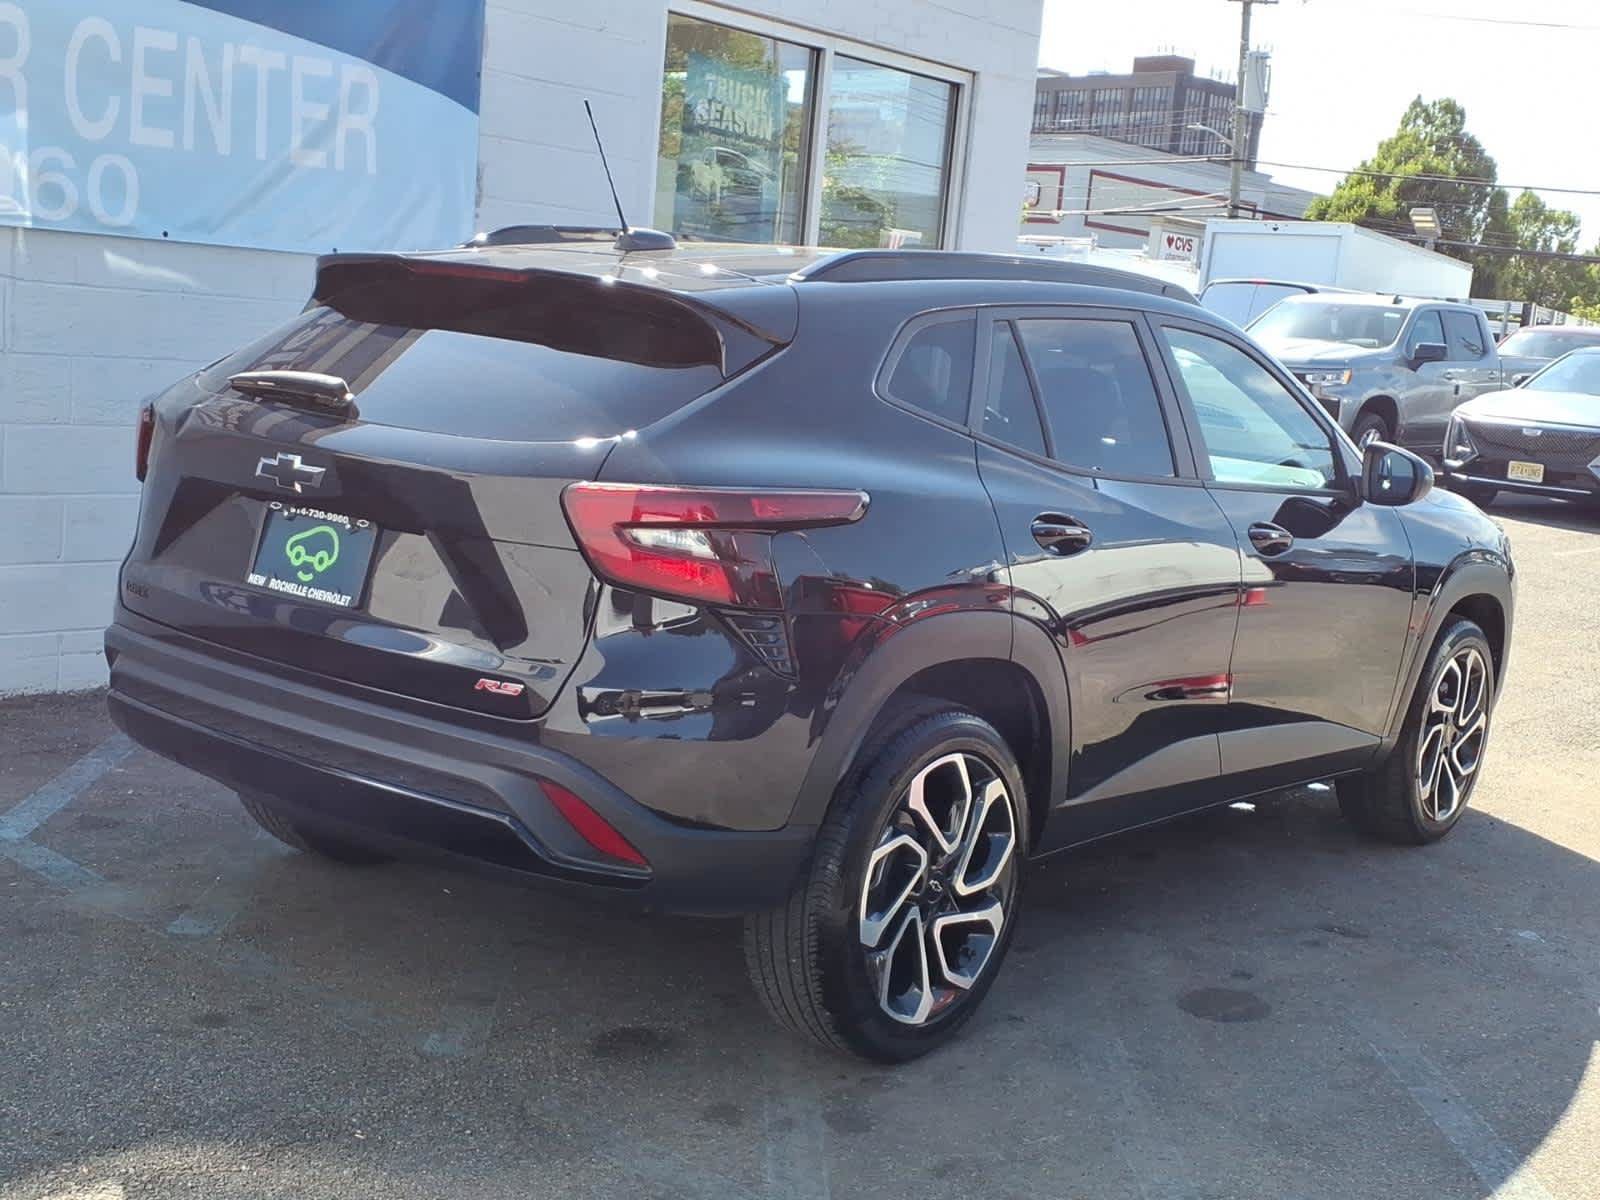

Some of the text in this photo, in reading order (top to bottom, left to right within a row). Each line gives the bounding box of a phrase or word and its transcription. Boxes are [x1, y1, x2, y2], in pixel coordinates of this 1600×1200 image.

[64, 16, 380, 175] CENTER
[703, 73, 770, 114] TRUCK
[694, 97, 773, 142] SEASON
[1175, 236, 1193, 252] CVS
[247, 573, 352, 607] NEW ROCHELLE CHEVROLET
[474, 678, 525, 696] RS
